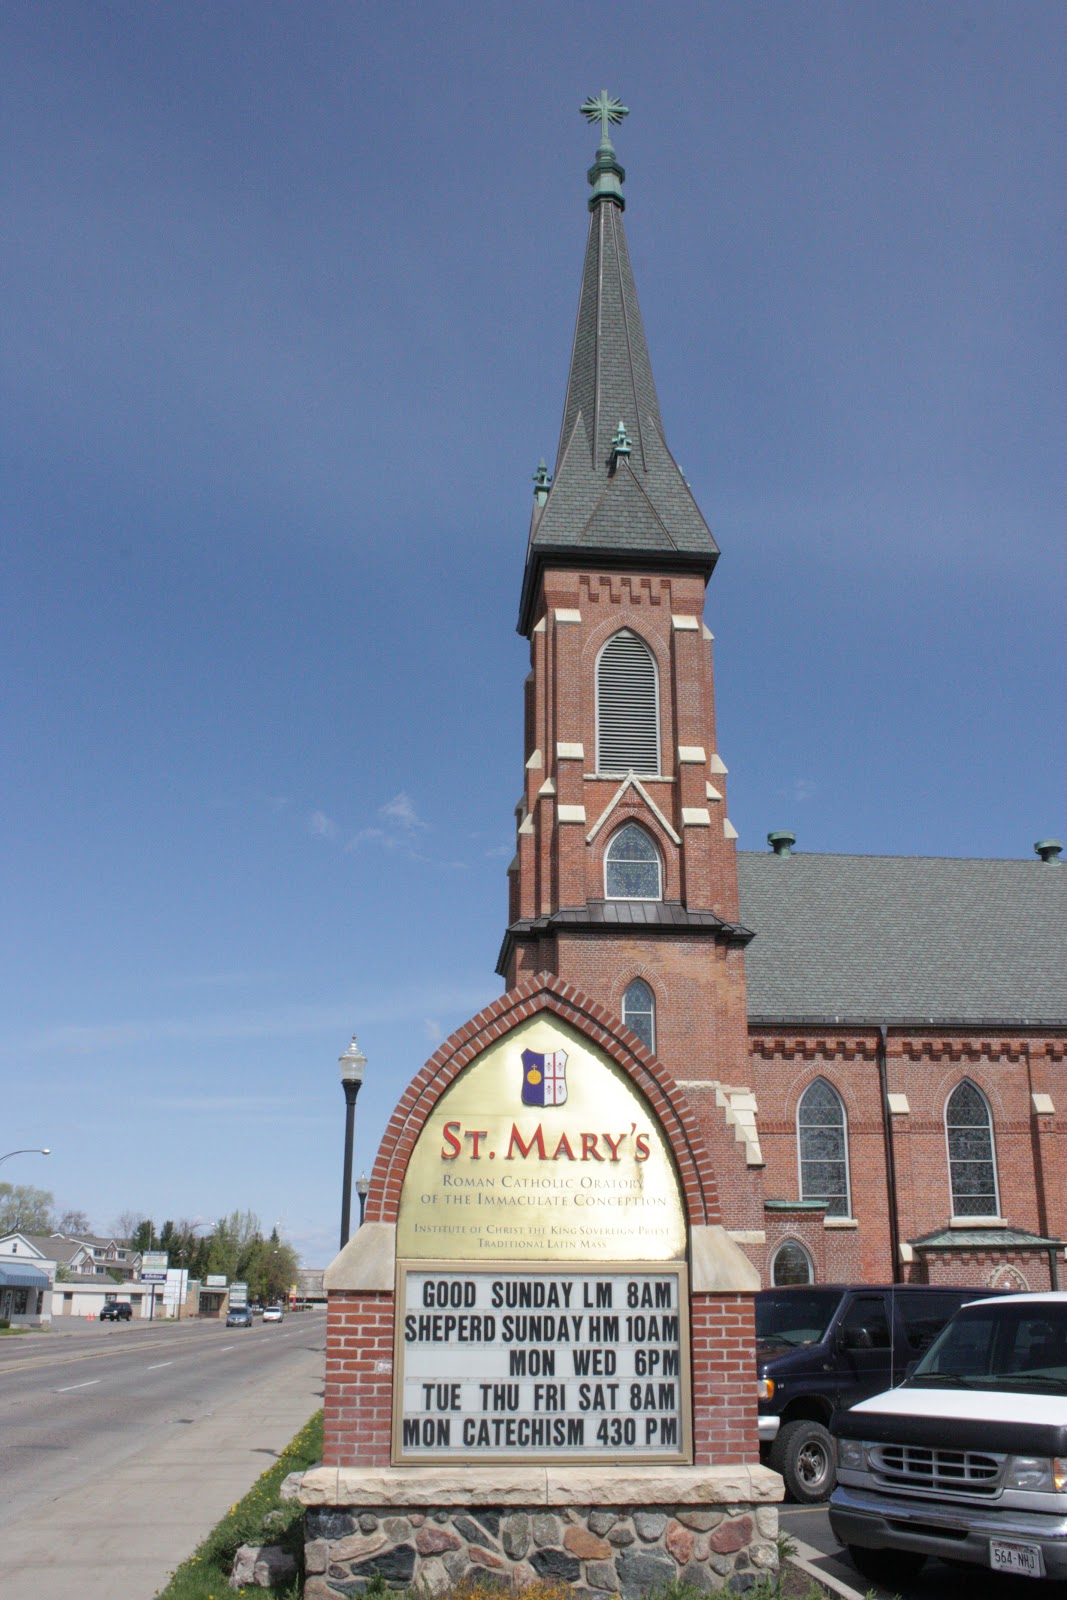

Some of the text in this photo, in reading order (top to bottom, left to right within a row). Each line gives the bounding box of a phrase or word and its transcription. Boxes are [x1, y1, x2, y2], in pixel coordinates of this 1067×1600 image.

[441, 1121, 651, 1162] ST. MARY'S
[442, 1174, 643, 1190] ROMAN CATHOLIC ORATORY
[420, 1192, 667, 1207] OF THE IMMACULATE CONCEPTION
[414, 1223, 670, 1236] INSTITUTE OF CHRIST THE KING SOVEREIGN PRIEST
[478, 1238, 608, 1250] TRADITIONAL LATIN MASS
[423, 1280, 671, 1308] GOOD SUNDAY LM 8AM
[404, 1315, 678, 1343] SHEPERD SUNDAY HM 10AM
[510, 1350, 679, 1376] MON WED 6PM
[423, 1384, 675, 1411] TUE THU FRI SAT 8AM
[403, 1418, 677, 1447] MON CATECHISM 430 PM
